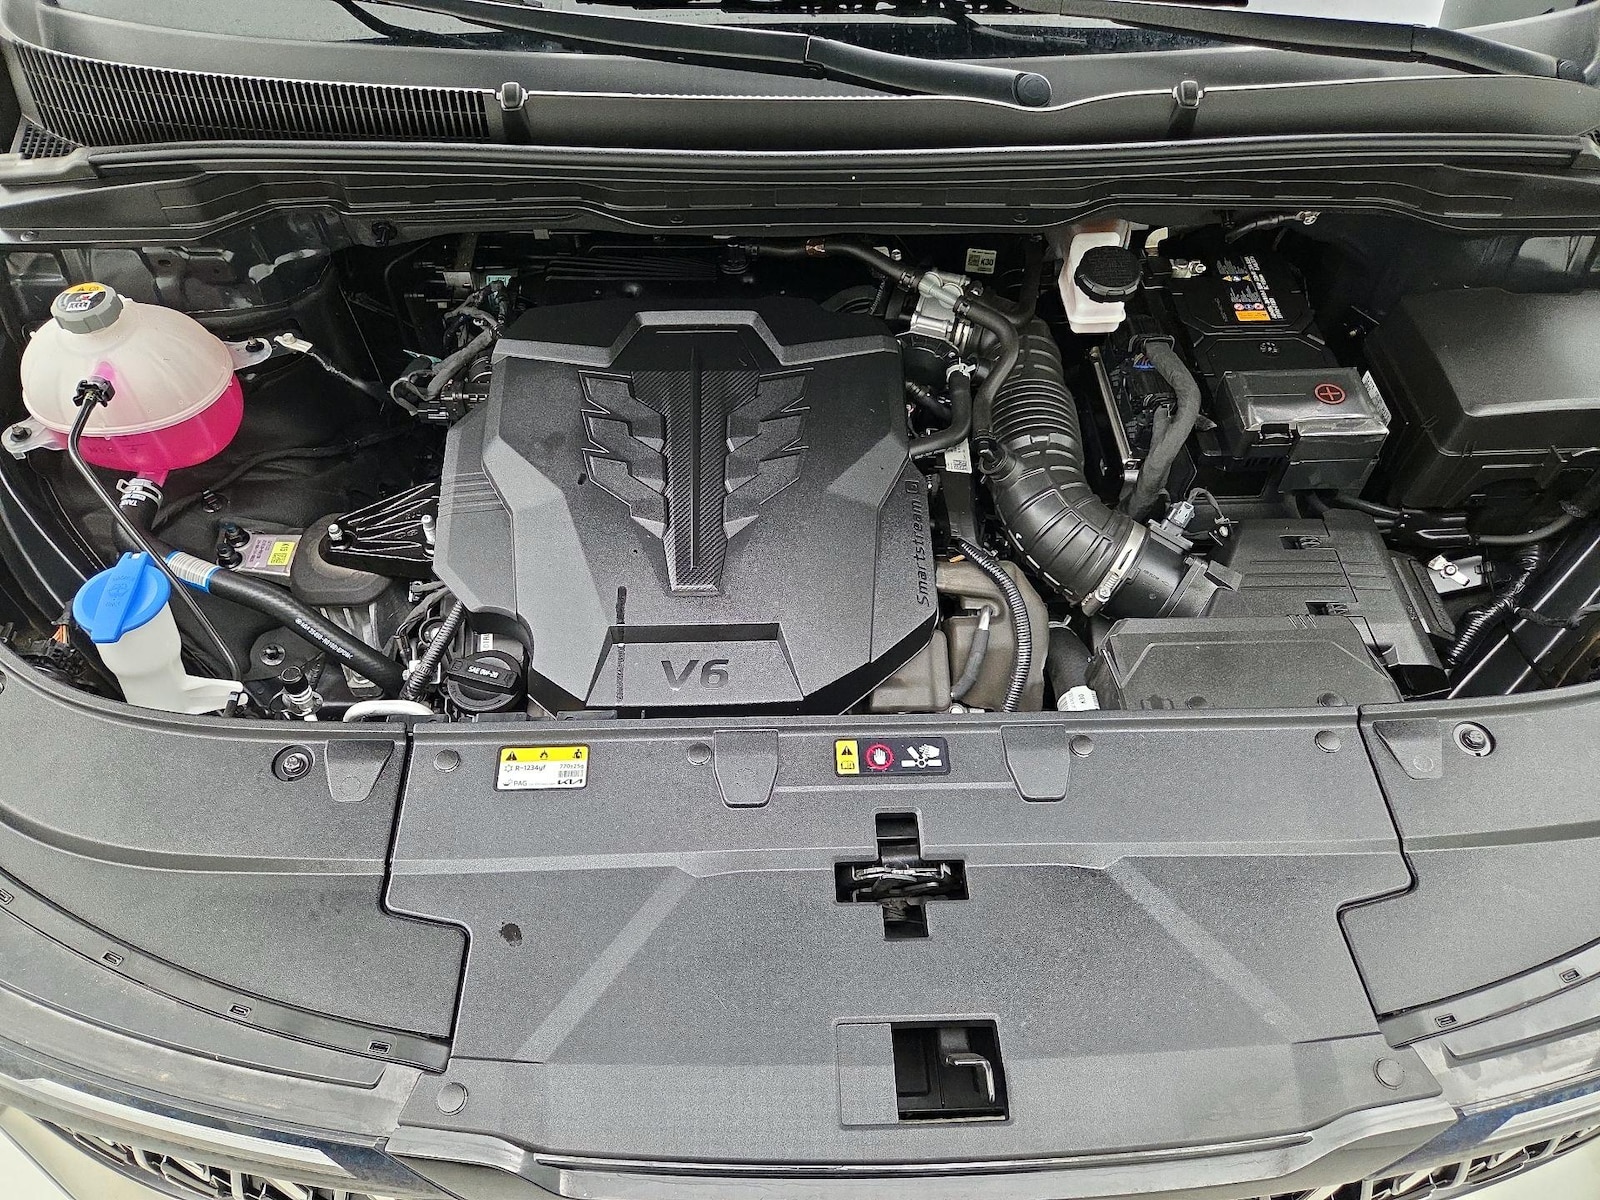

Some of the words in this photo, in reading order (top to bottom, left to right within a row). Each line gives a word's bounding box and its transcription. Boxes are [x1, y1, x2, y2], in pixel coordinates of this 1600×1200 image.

[980, 258, 994, 266] K30
[912, 499, 930, 608] Smartstream
[468, 666, 481, 674] SAE
[480, 668, 500, 679] 0W-20
[660, 659, 730, 691] V6
[515, 764, 546, 772] R-1234yf
